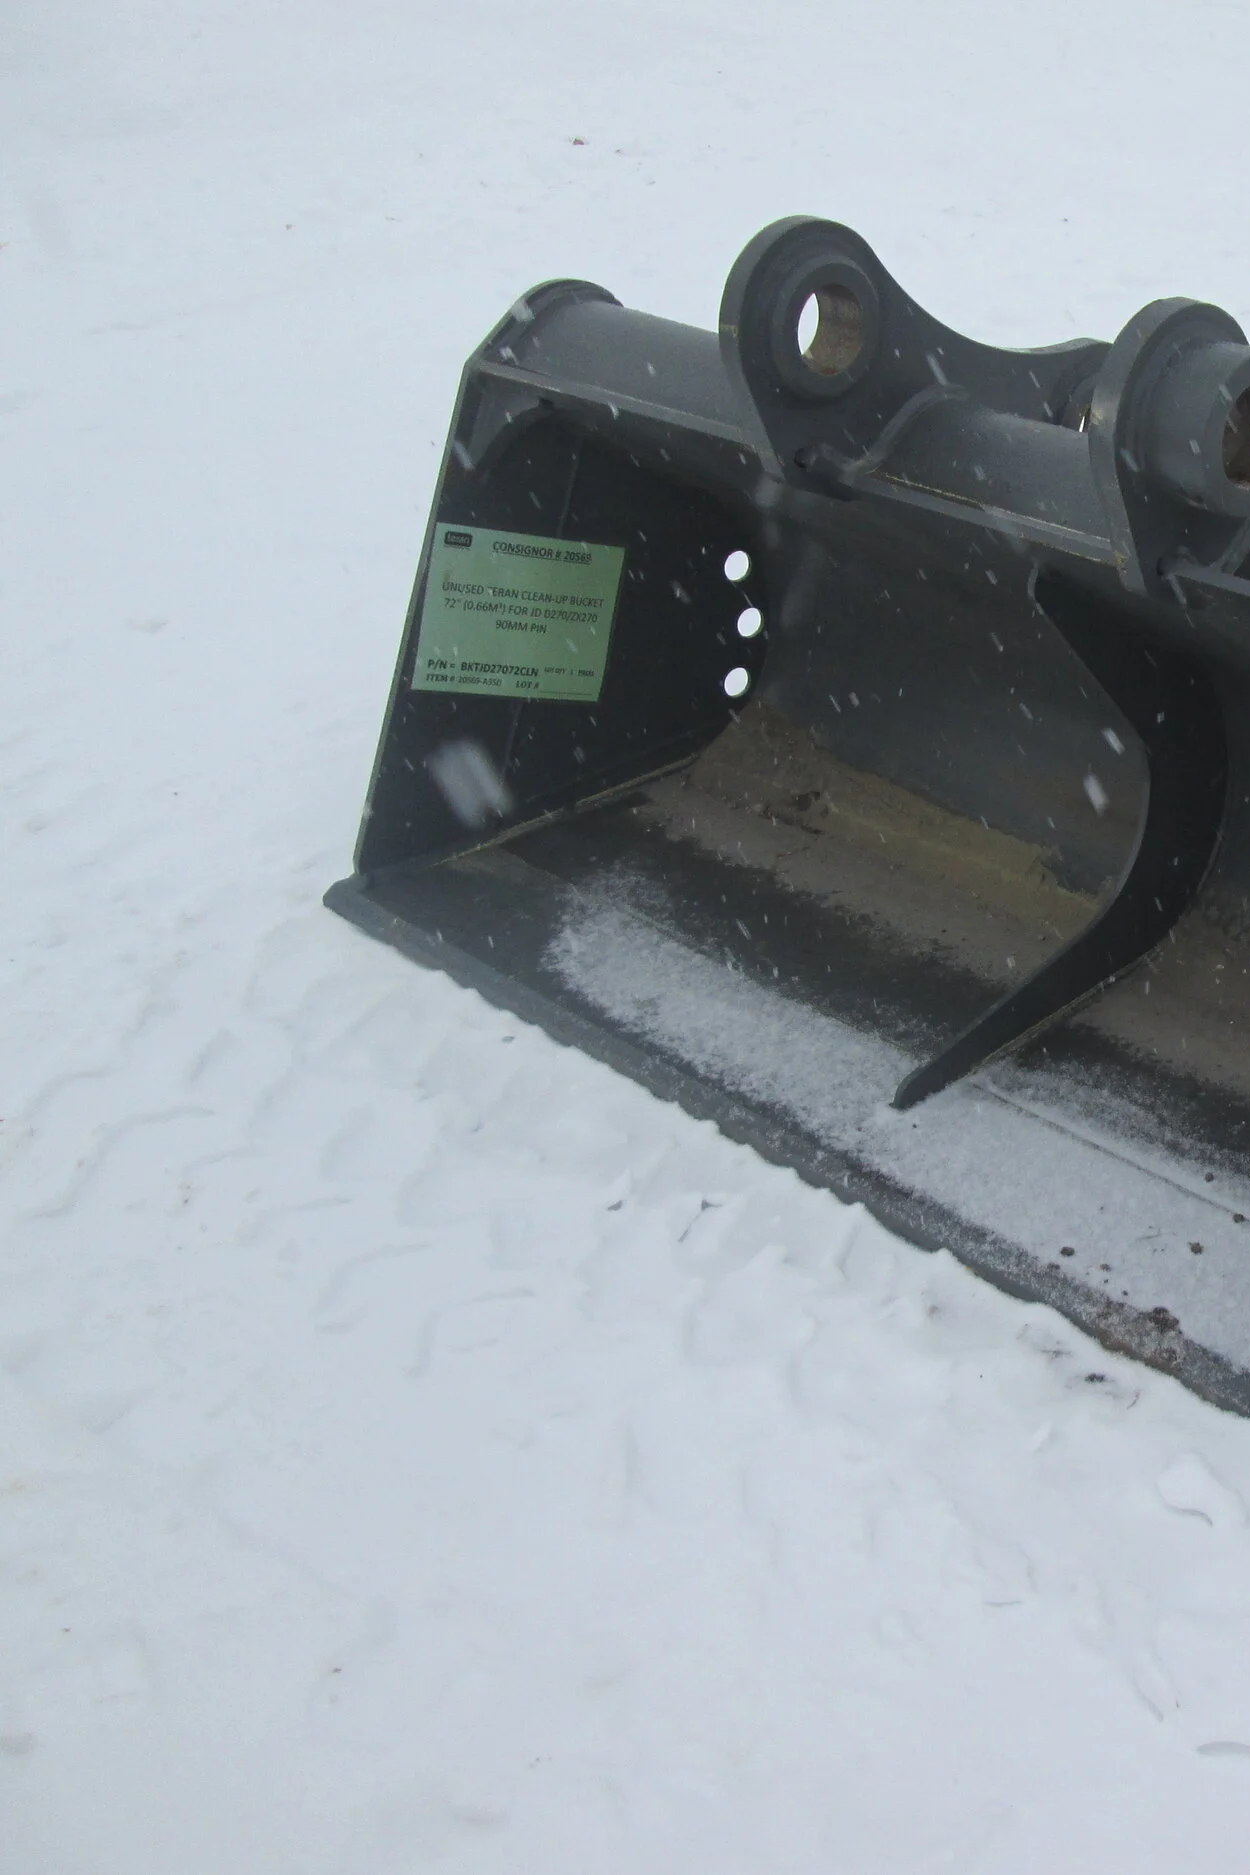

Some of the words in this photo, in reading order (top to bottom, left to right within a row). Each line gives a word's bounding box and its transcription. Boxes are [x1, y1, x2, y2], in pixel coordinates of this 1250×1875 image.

[493, 541, 553, 558] CONSIGNOR
[555, 550, 561, 559] #
[442, 581, 484, 595] UNUSED
[521, 590, 568, 604] CLEAN-UP
[570, 595, 604, 608] BUCKET
[508, 604, 528, 616] FOR
[495, 619, 528, 632] 90MM
[530, 622, 547, 634] PIN
[427, 659, 447, 670] P/N
[461, 661, 539, 677] BKTJD27072CLN
[426, 673, 448, 683] ITEM
[515, 680, 532, 689] LOT
